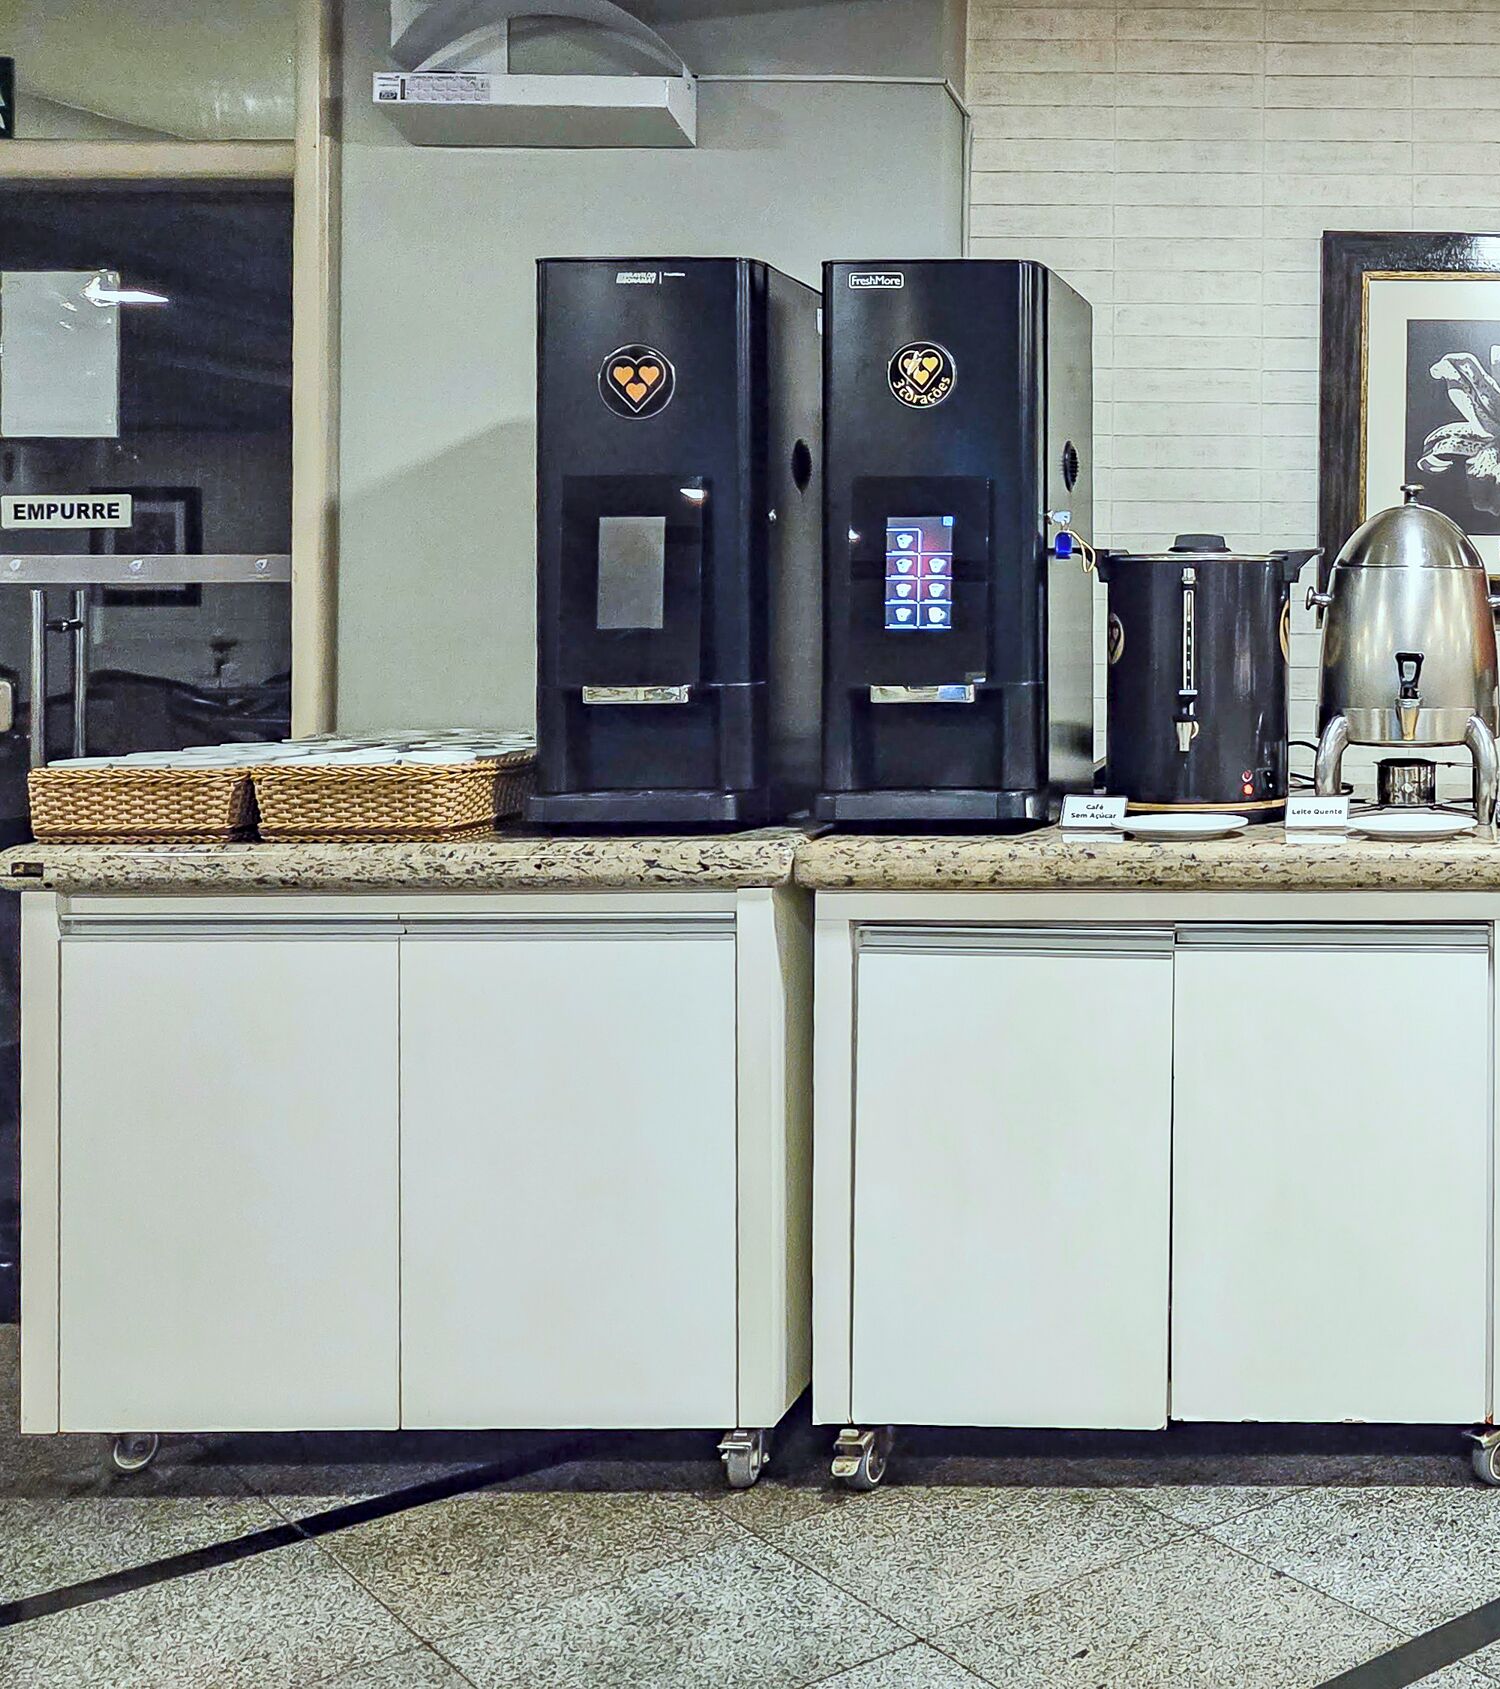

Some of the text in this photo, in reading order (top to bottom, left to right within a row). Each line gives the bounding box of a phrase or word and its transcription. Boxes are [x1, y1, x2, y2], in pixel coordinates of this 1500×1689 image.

[851, 275, 901, 286] FreshMore
[892, 376, 951, 404] 3 corações
[13, 503, 120, 520] EMPURRE
[1089, 811, 1117, 819] Açúcar
